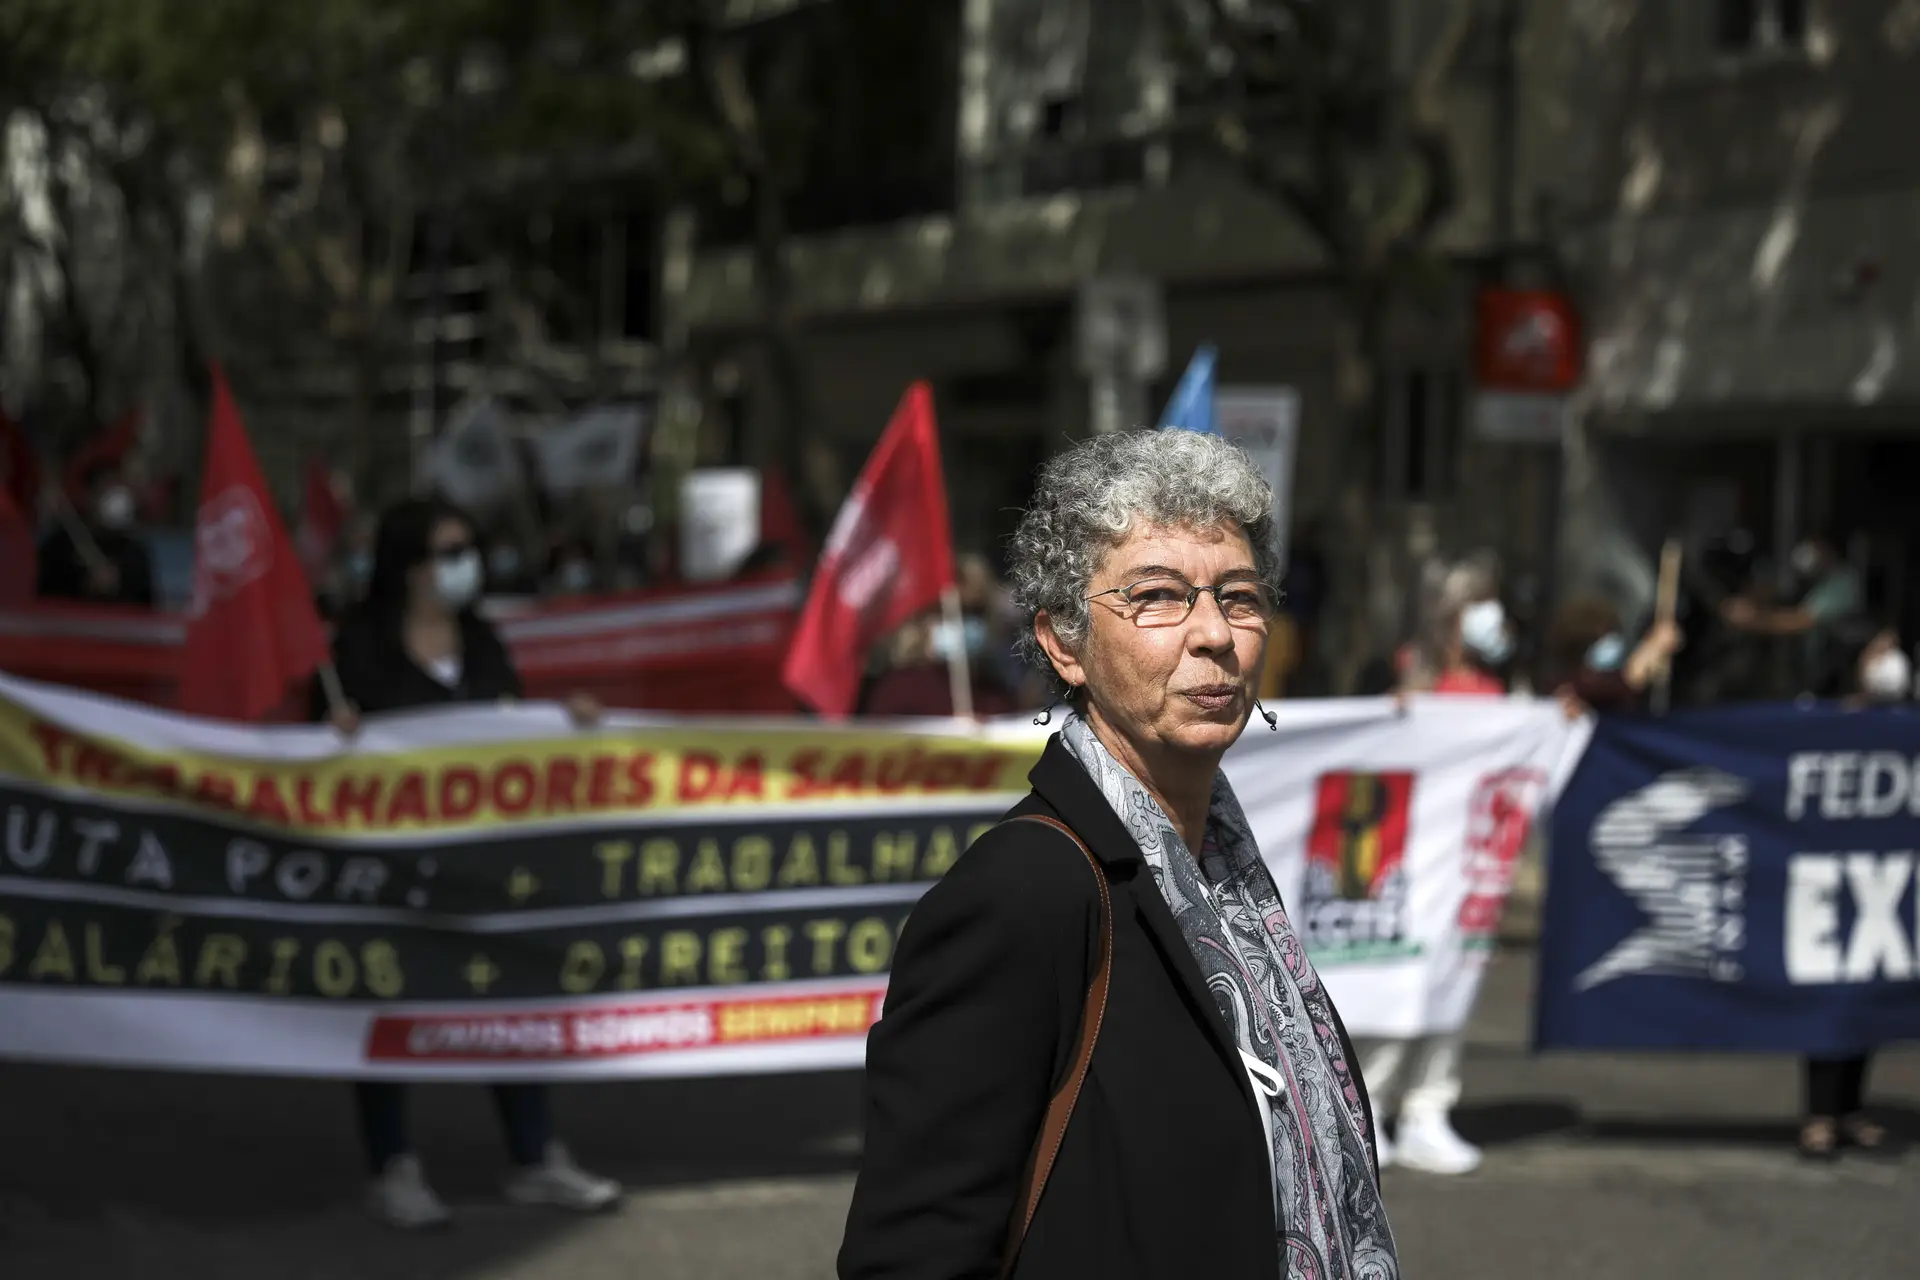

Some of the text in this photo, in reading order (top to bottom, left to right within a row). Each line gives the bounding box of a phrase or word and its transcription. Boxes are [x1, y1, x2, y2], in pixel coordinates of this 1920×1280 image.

[676, 751, 764, 800] DA
[0, 804, 175, 890] UTA
[594, 823, 996, 897] TRABALHA
[560, 916, 908, 994] DIREITO
[1784, 852, 1920, 984] EX
